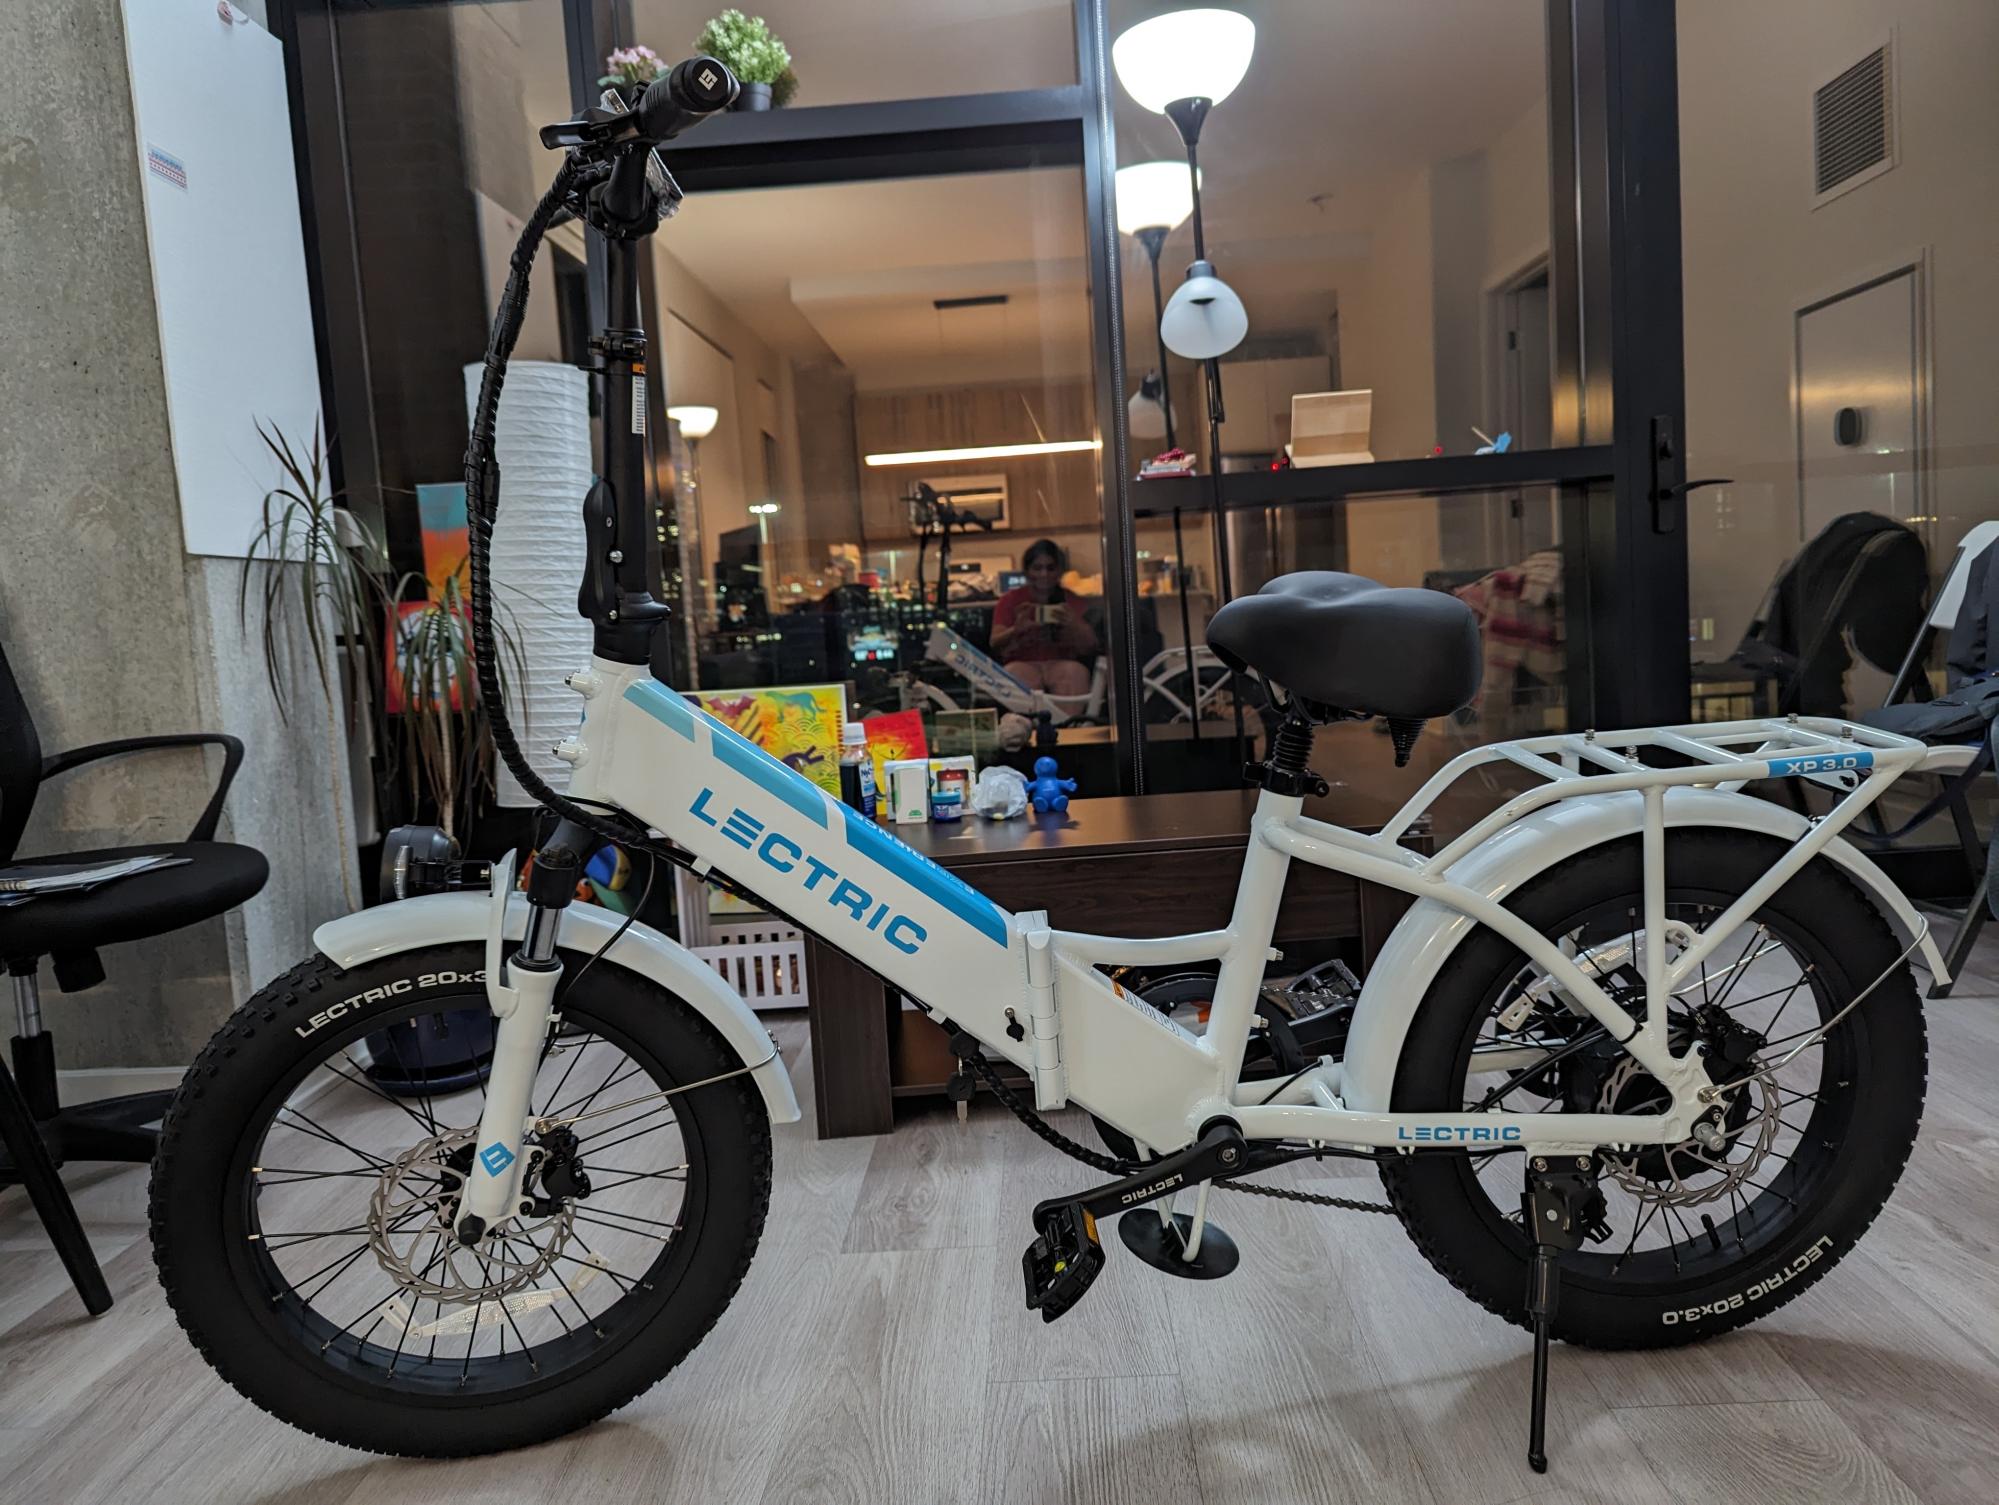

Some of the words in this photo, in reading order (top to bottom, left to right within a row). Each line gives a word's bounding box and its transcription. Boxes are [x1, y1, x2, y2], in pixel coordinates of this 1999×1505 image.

[1786, 761, 1817, 774] XP
[1822, 757, 1857, 770] 3.0
[689, 788, 927, 955] LECTRIC
[294, 979, 413, 1038] LECTRIC
[417, 970, 486, 989] 20x3
[1398, 1127, 1521, 1141] LECTRIC
[1121, 1173, 1184, 1204] LECTRIC
[1746, 1235, 1834, 1301] LECTRIC
[1662, 1293, 1745, 1325] 20x3.0
